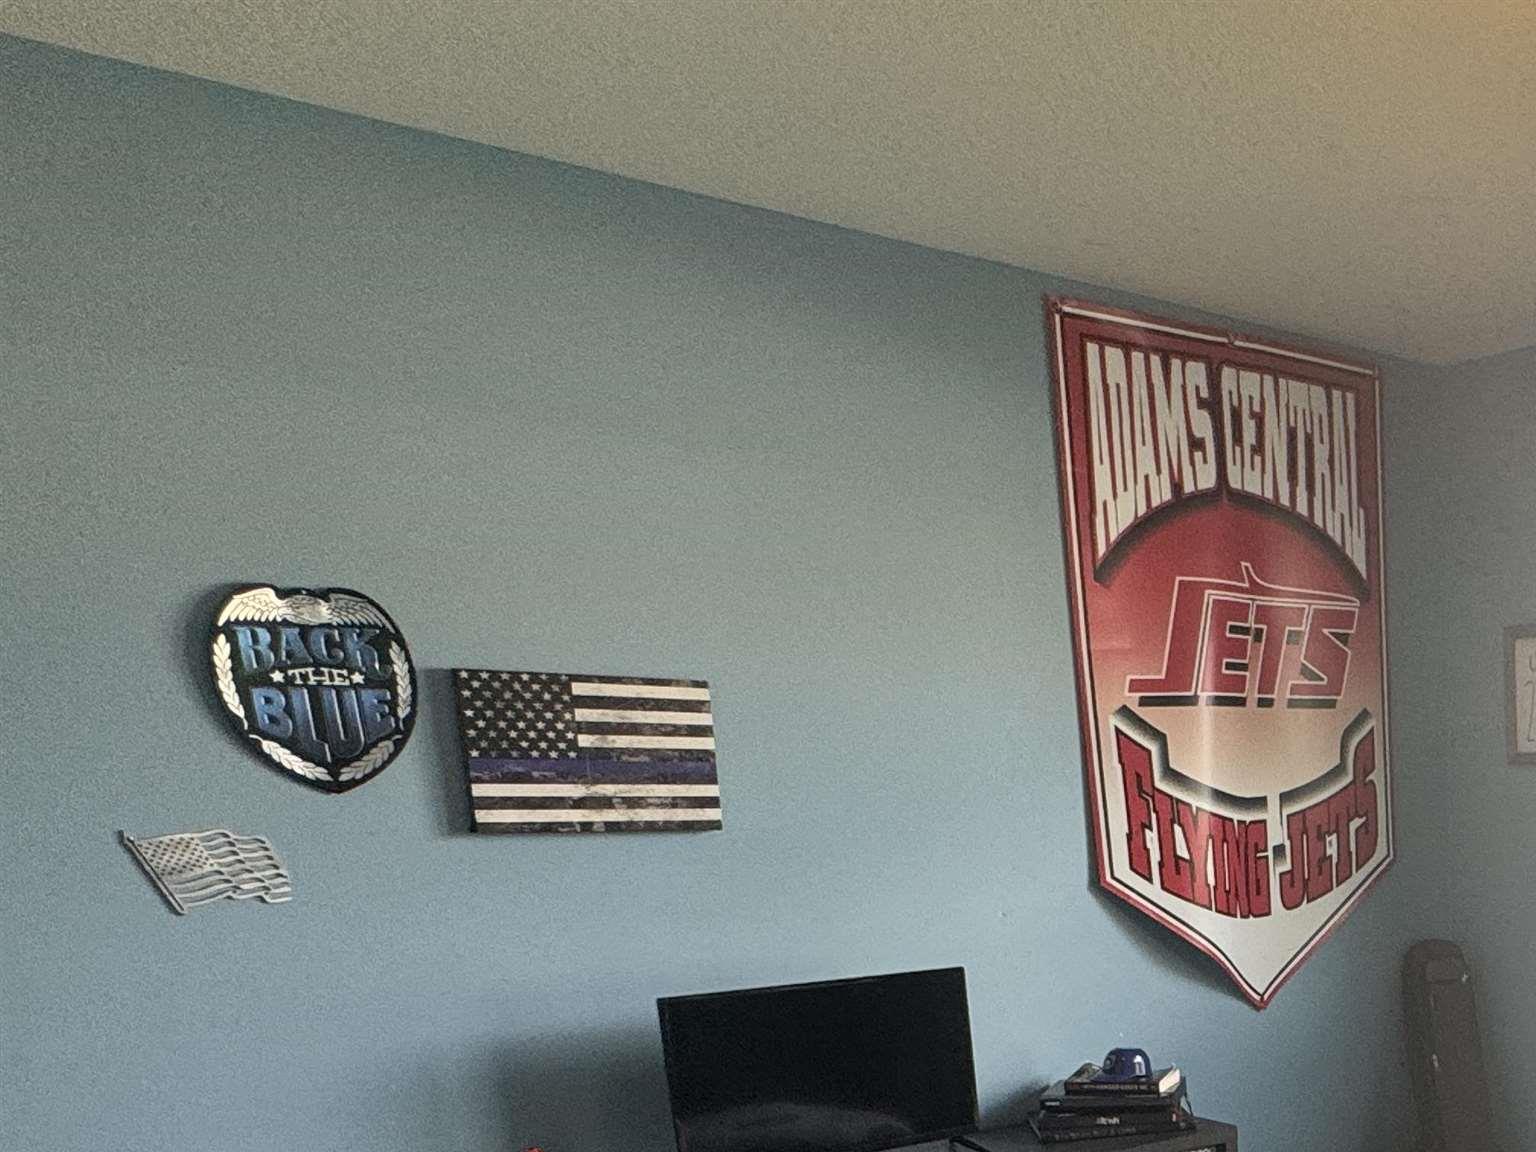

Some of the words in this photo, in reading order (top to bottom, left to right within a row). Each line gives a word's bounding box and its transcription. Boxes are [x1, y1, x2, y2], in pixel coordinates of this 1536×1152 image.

[1085, 341, 1218, 558] ADAMS
[1220, 364, 1367, 581] CENTRAL
[232, 624, 392, 681] BACK
[287, 666, 351, 686] THE
[1125, 562, 1361, 698] JETS
[251, 685, 397, 764] BLUE
[1115, 725, 1272, 918] FLYING
[1279, 727, 1380, 911] JETS
